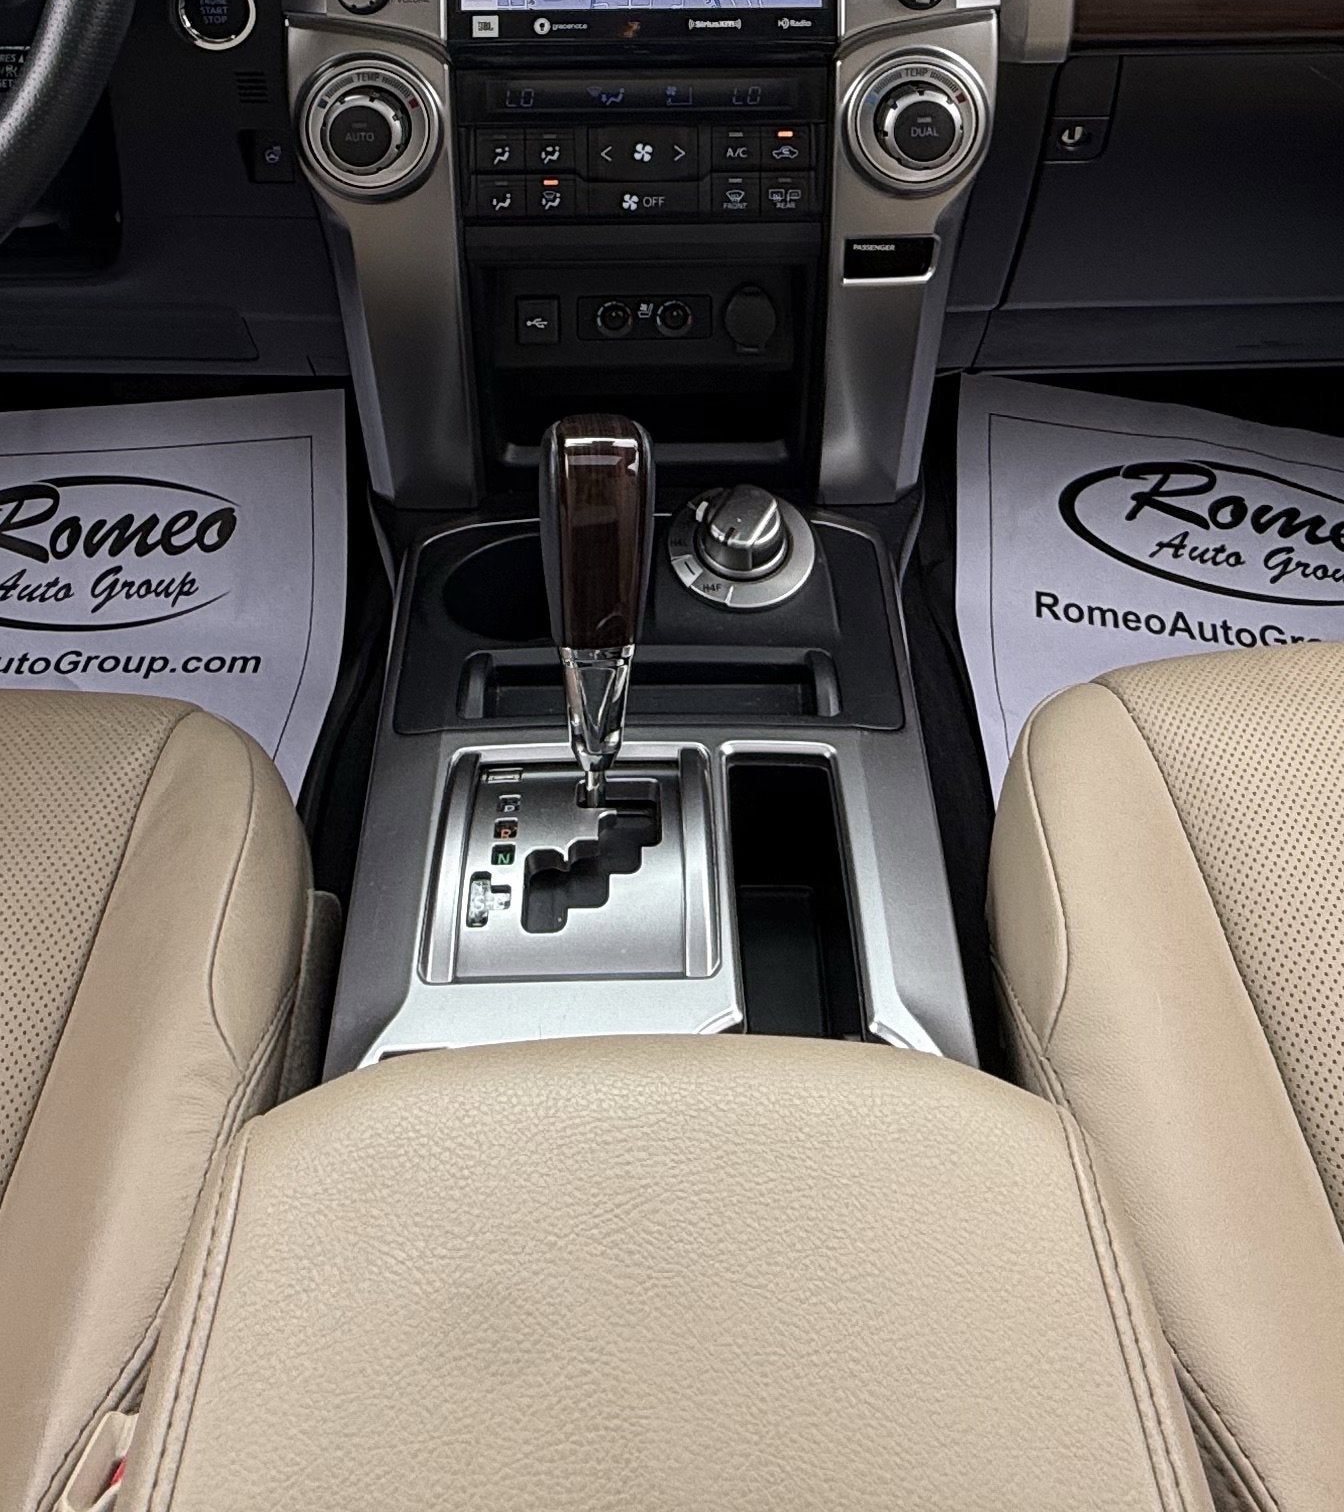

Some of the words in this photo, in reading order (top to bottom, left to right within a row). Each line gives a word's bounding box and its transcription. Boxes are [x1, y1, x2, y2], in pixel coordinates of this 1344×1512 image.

[199, 6, 228, 14] START
[204, 15, 227, 24] STOP
[355, 72, 380, 84] TEMP
[905, 67, 929, 79] TEMP
[344, 131, 375, 142] AUTO
[910, 126, 939, 137] DUAL
[726, 147, 747, 158] A/C
[642, 196, 665, 208] OFF
[723, 202, 747, 210] FRONT
[853, 243, 895, 251] PASSENGER
[1150, 530, 1246, 569] Auto
[90, 565, 199, 613] Group
[702, 583, 722, 592] H4F
[504, 803, 515, 813] P
[500, 828, 511, 840] R
[497, 853, 510, 865] N
